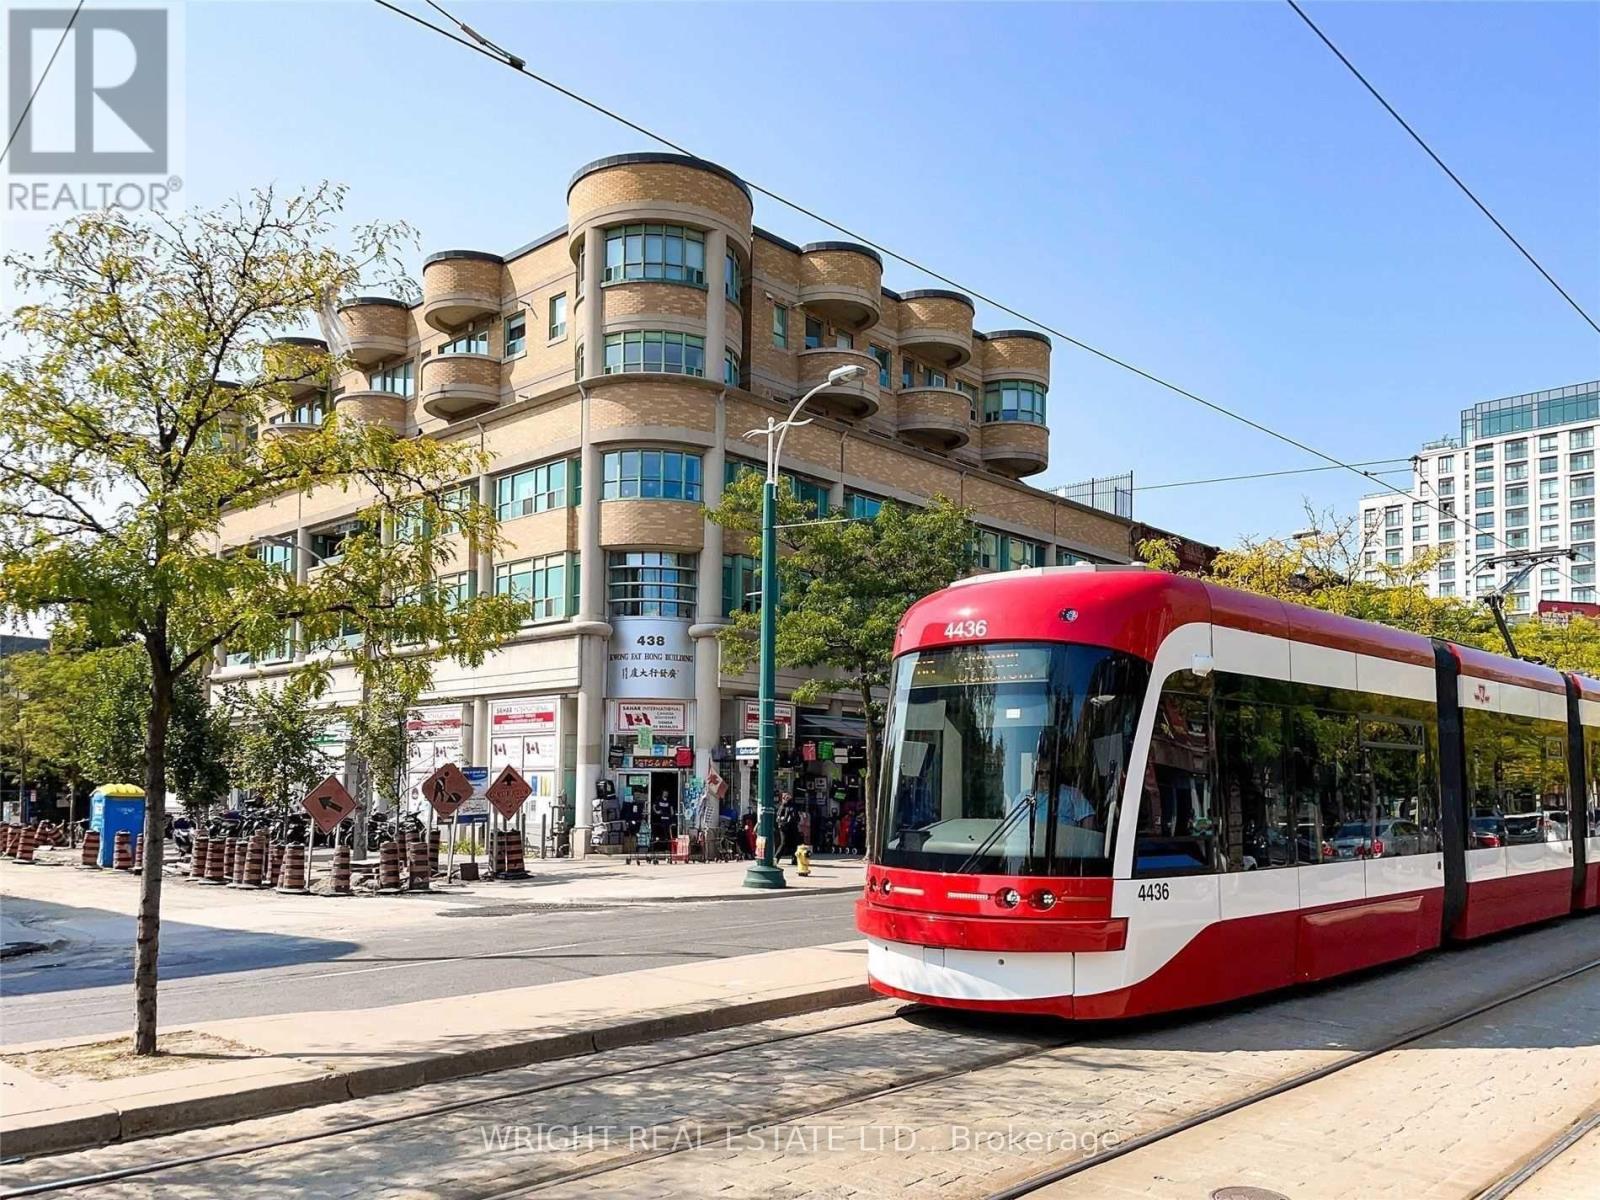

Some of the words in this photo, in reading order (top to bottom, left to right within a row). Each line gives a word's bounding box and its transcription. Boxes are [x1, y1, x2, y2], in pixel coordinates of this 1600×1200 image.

[943, 619, 988, 639] 4436
[636, 635, 666, 646] 438
[644, 652, 663, 661] HONG
[1138, 882, 1170, 902] 4436
